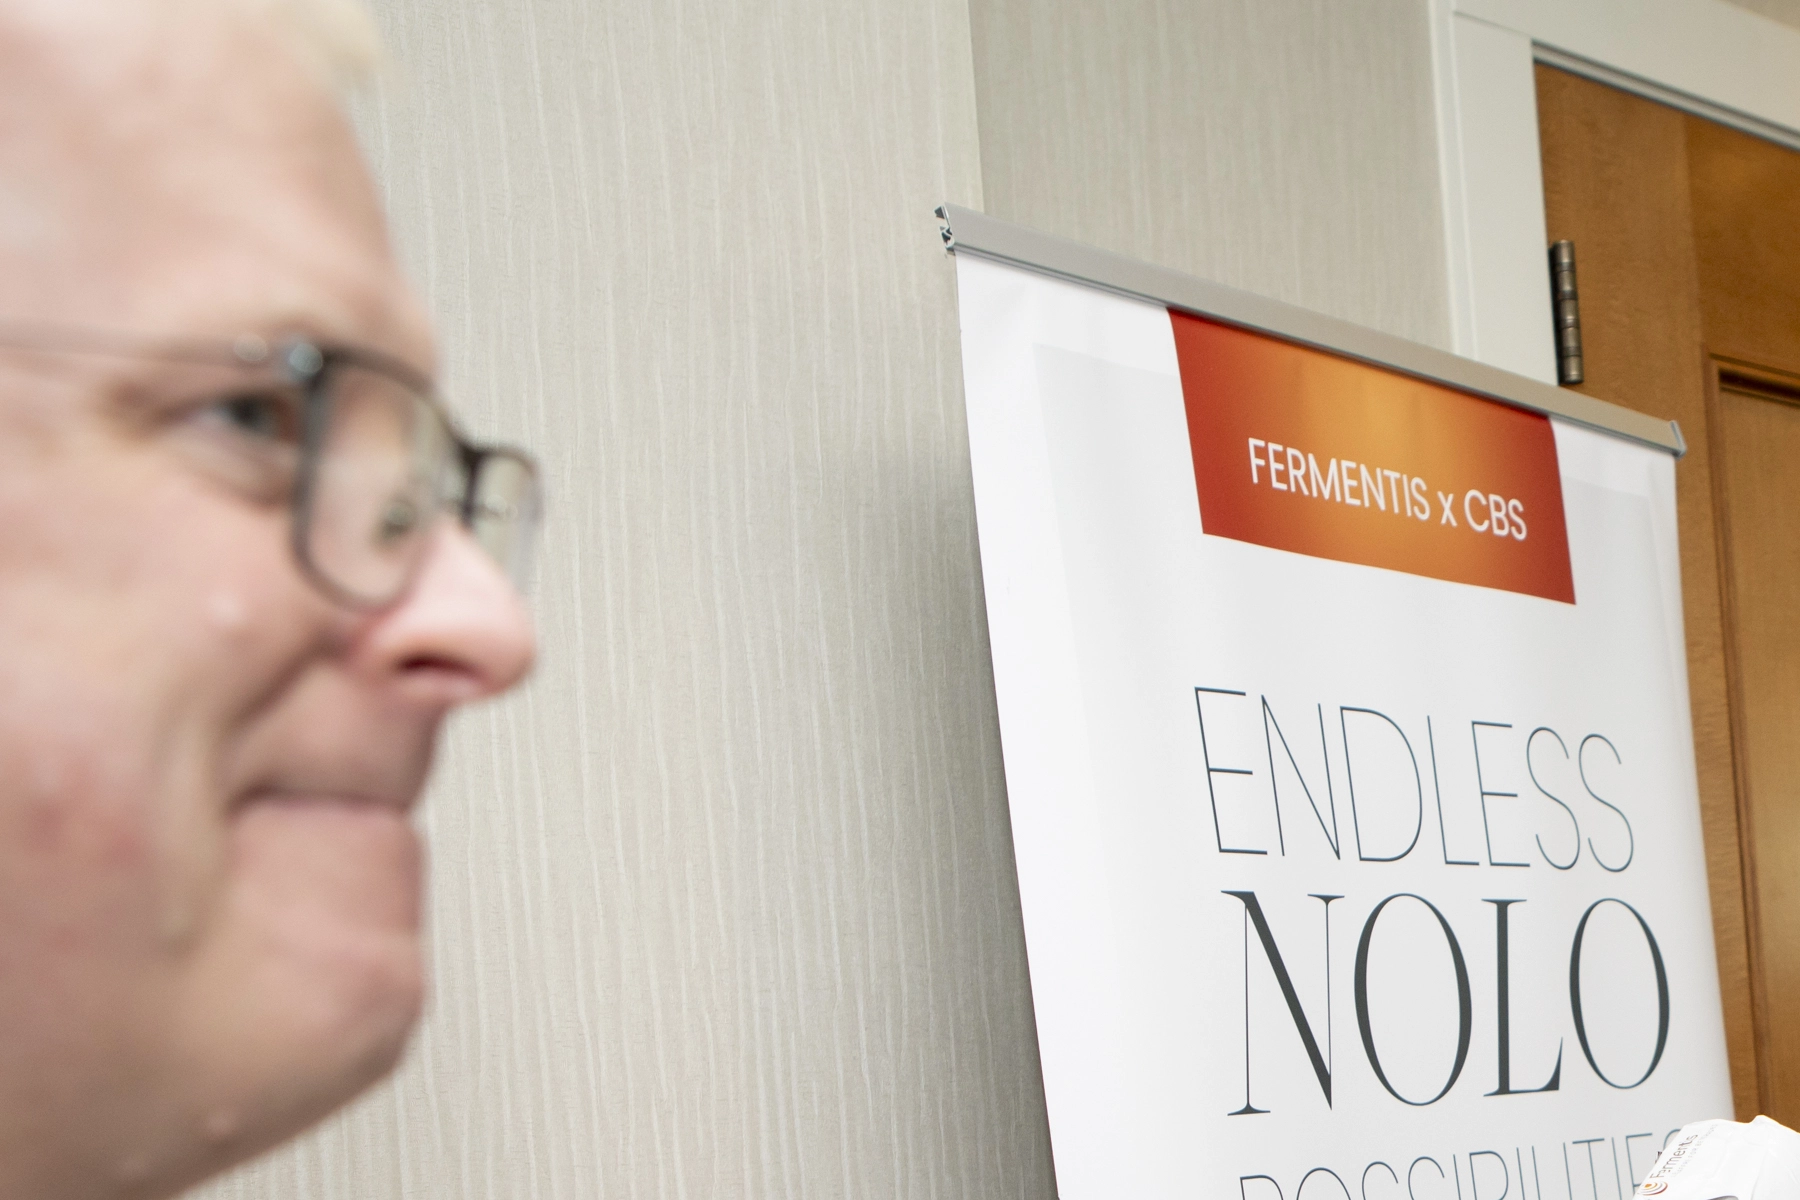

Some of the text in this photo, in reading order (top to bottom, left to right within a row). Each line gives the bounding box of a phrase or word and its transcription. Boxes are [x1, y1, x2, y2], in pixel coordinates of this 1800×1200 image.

[1248, 437, 1527, 541] FERMENTIS x CBS
[1194, 687, 1634, 873] ENDLESS
[1221, 890, 1669, 1116] NOLO
[1650, 1135, 1698, 1178] Fermentis
